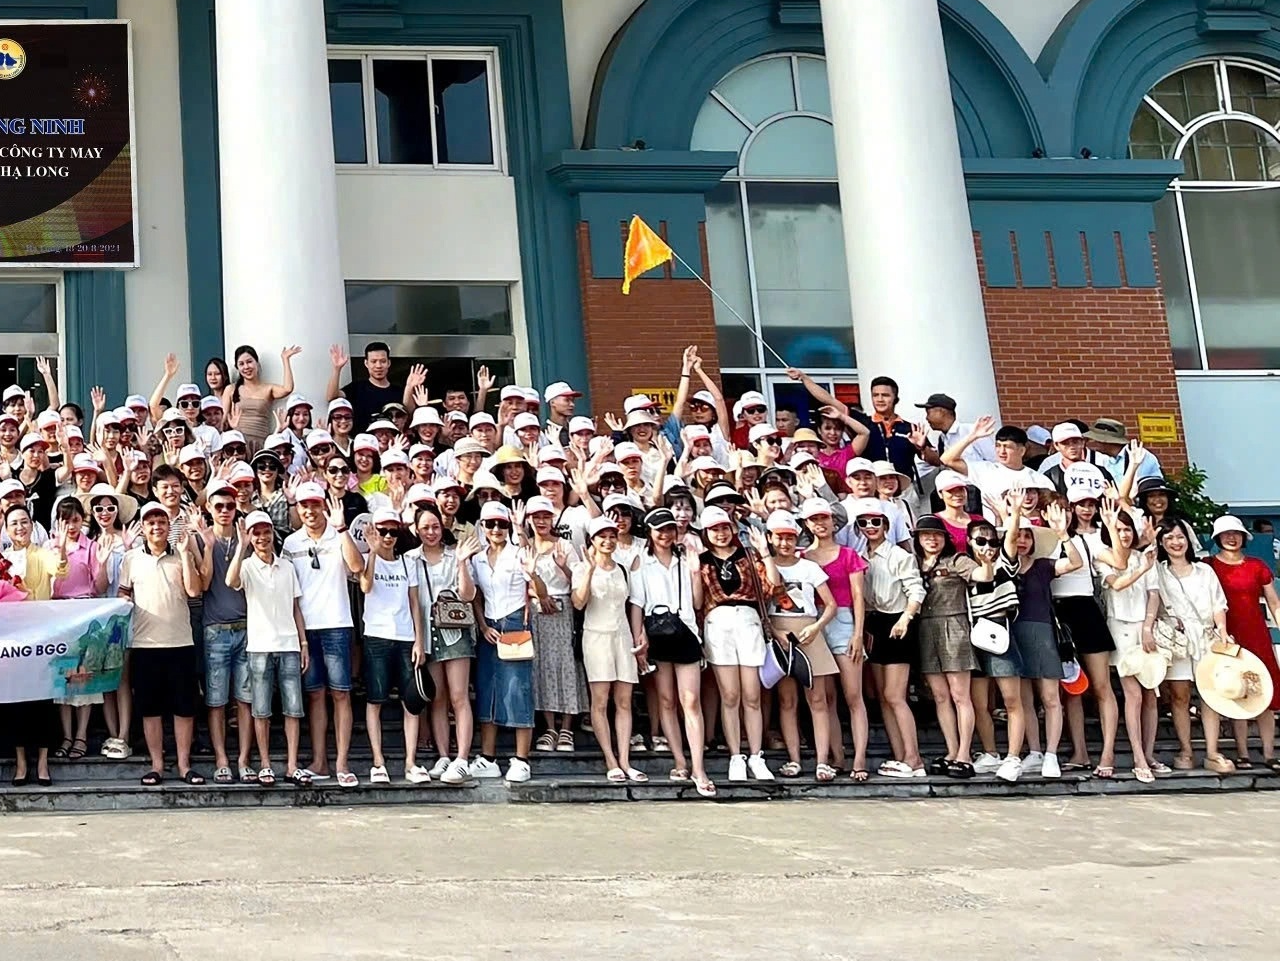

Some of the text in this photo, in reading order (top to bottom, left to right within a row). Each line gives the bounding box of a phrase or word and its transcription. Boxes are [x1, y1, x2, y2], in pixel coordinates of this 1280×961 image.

[30, 118, 86, 135] NINH
[46, 146, 67, 159] TY
[70, 147, 104, 159] MAY
[0, 166, 22, 180] HẠ
[26, 166, 70, 178] LONG
[35, 643, 67, 656] BGG
